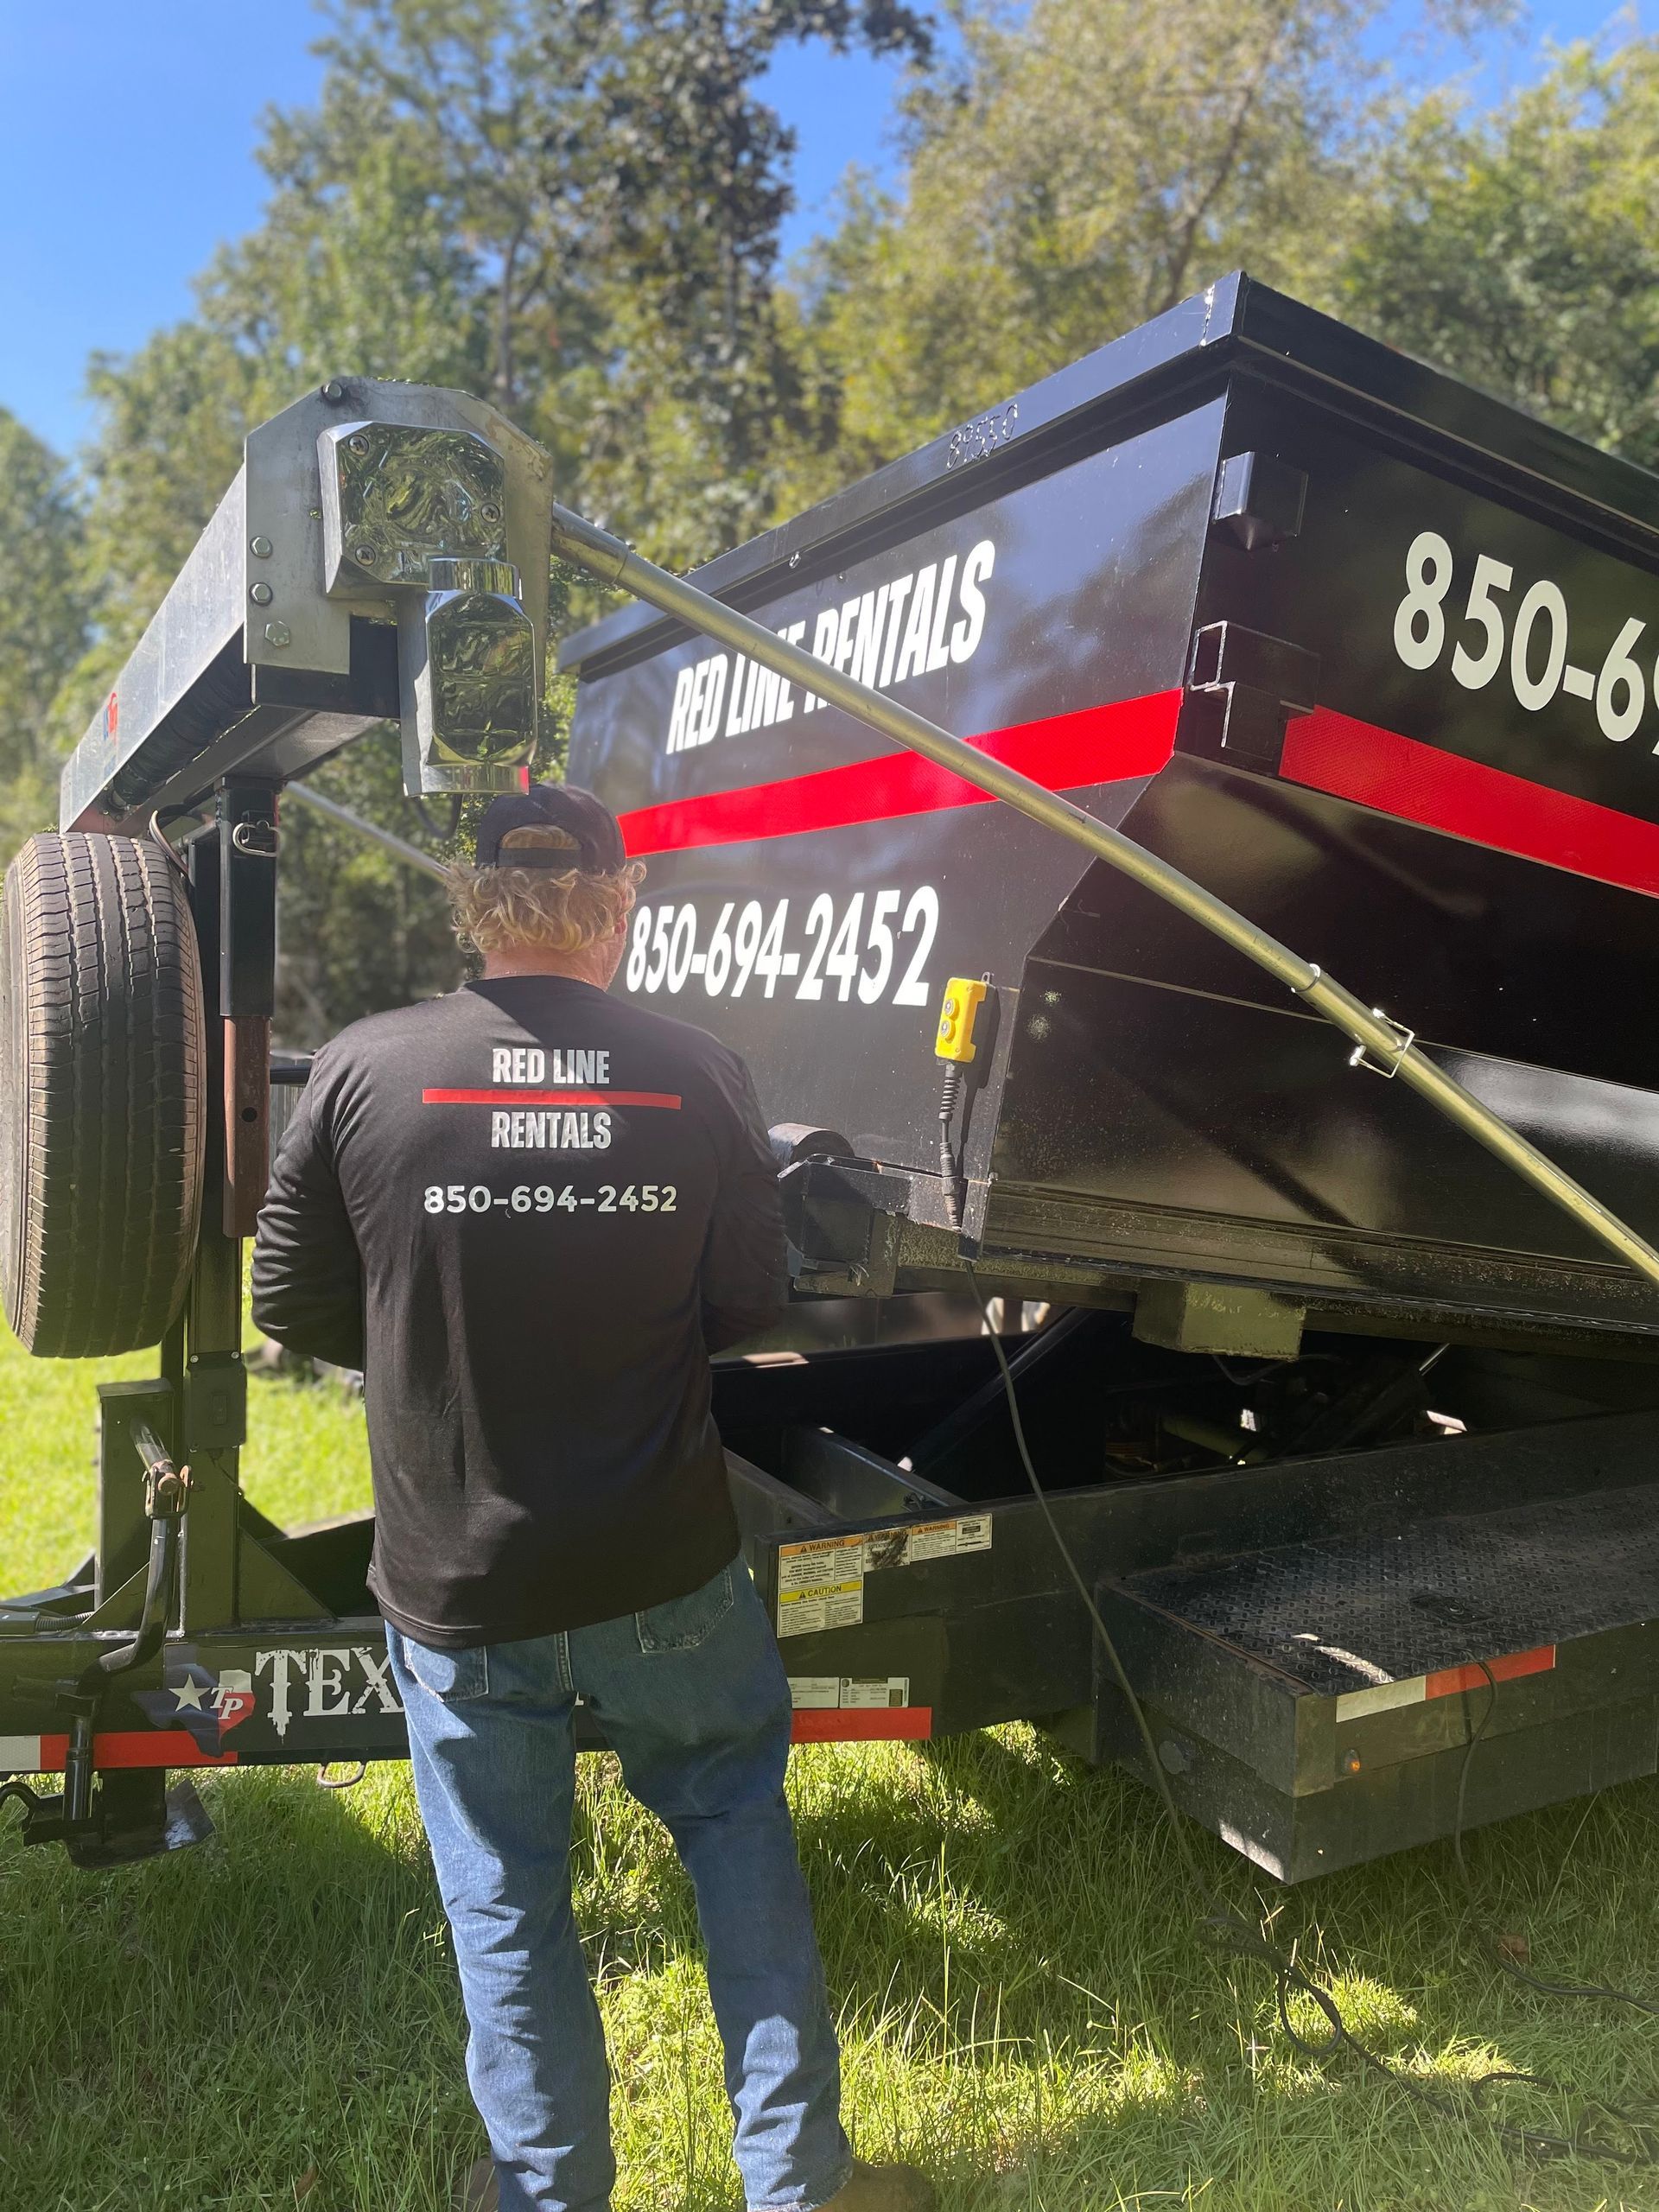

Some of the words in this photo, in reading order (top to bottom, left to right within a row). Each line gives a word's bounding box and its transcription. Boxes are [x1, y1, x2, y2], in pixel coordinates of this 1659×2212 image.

[665, 653, 728, 755] RED
[725, 620, 806, 738] LINE
[803, 539, 996, 715] RENTALS
[1394, 531, 1659, 756] 850-6
[626, 886, 939, 1007] 850-694-2452
[492, 1048, 546, 1084] RED
[552, 1048, 611, 1085] LINE
[490, 1111, 613, 1149] RENTALS
[423, 1185, 678, 1214] 850-694-2452
[809, 1539, 845, 1551] WARNING
[924, 1522, 950, 1532] WARNING
[807, 1585, 842, 1597] CAUTION
